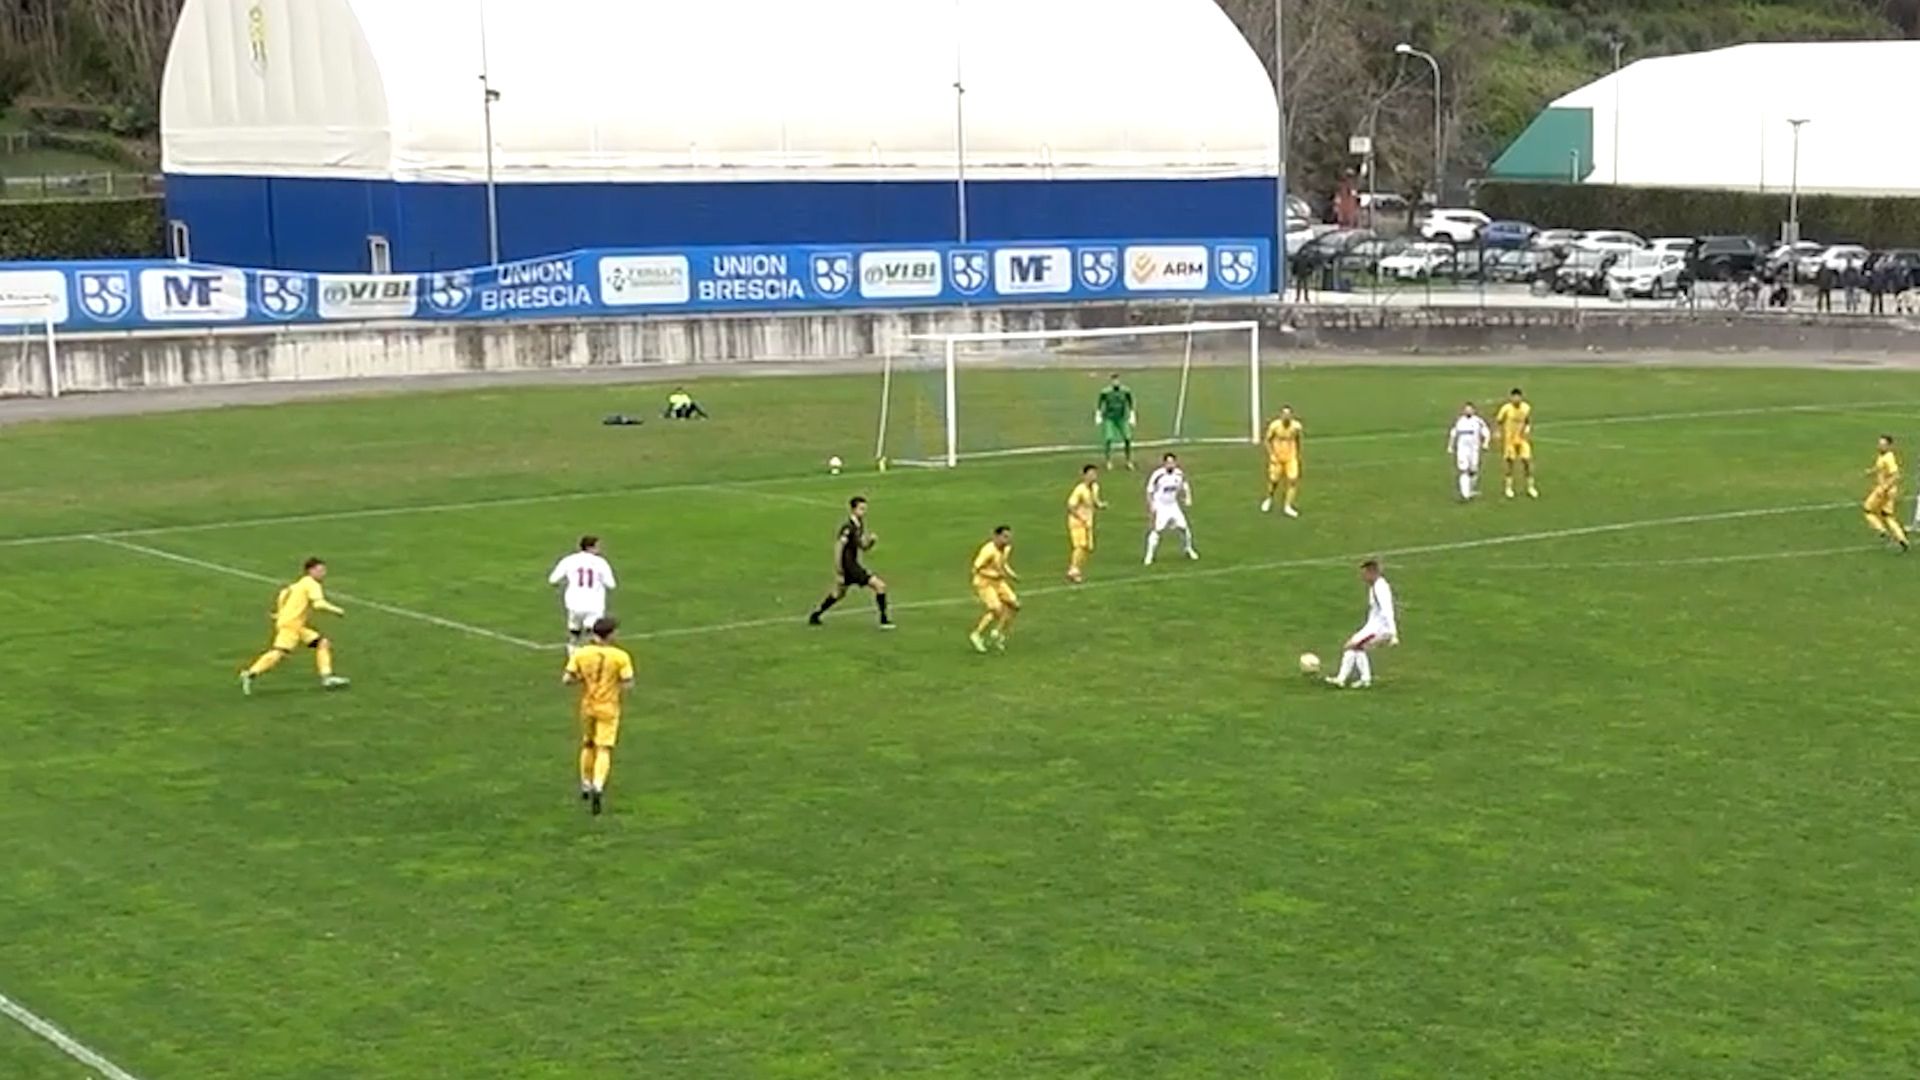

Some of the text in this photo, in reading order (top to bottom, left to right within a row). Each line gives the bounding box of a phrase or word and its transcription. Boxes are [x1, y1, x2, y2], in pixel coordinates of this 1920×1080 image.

[498, 261, 573, 284] UNION
[713, 255, 787, 277] UNION
[1010, 255, 1053, 282] MF
[1162, 261, 1203, 277] ARM
[163, 275, 222, 306] MF
[481, 284, 592, 311] BRESCIA
[699, 279, 805, 300] BRESCIA
[577, 567, 594, 589] 11
